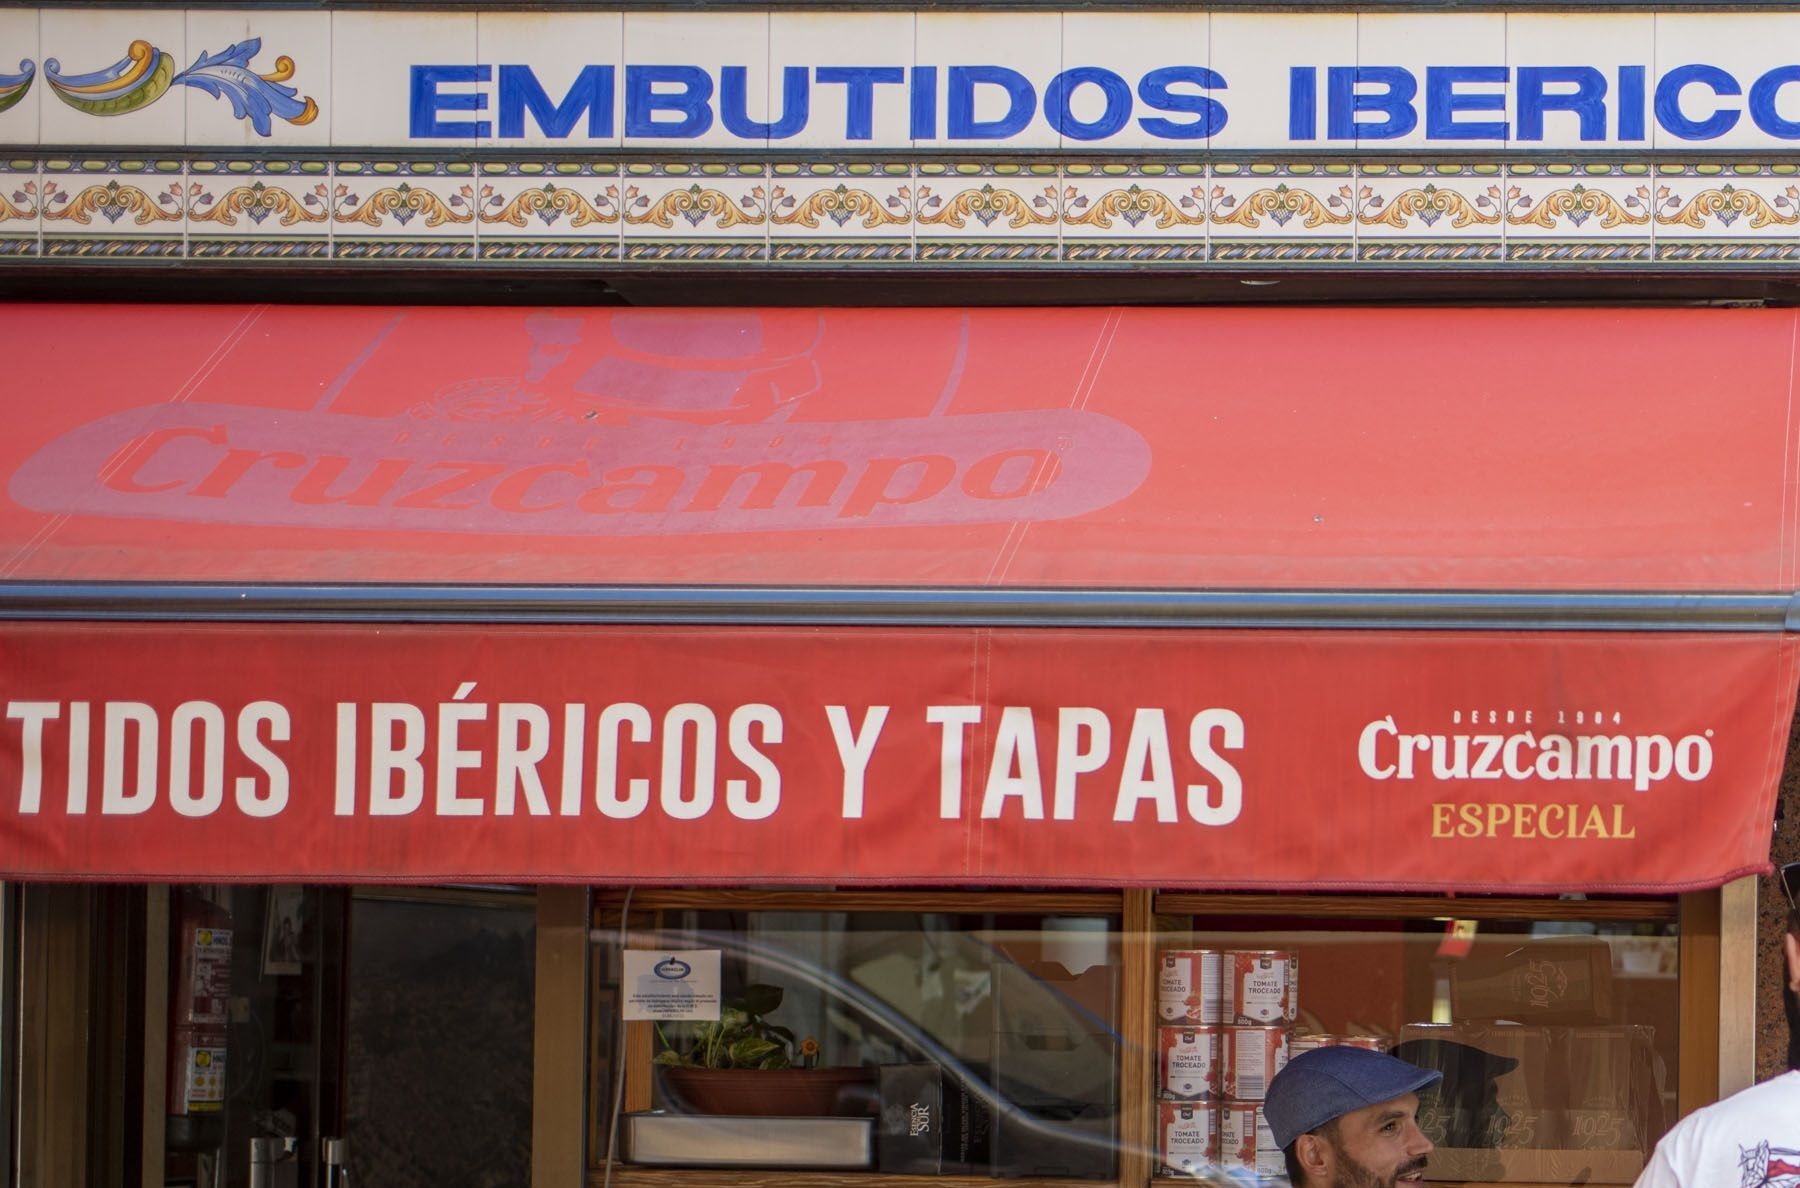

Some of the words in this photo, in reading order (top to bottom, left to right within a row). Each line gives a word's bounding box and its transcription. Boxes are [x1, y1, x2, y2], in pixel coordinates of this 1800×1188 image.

[409, 65, 1229, 142] EMBUTIDOS
[98, 424, 1068, 518] Cruzcampo
[335, 681, 783, 820] IBÉRICOS
[825, 705, 889, 818] Y
[927, 704, 1245, 826] TAPAS
[1358, 714, 1714, 791] Cruzcampo
[1453, 710, 1533, 725] DESDE
[1558, 710, 1622, 725] 1904
[5, 701, 291, 817] TIDOS
[1431, 803, 1636, 839] ESPECIAL
[918, 1103, 930, 1133] SUR
[1572, 1111, 1625, 1146] 1925
